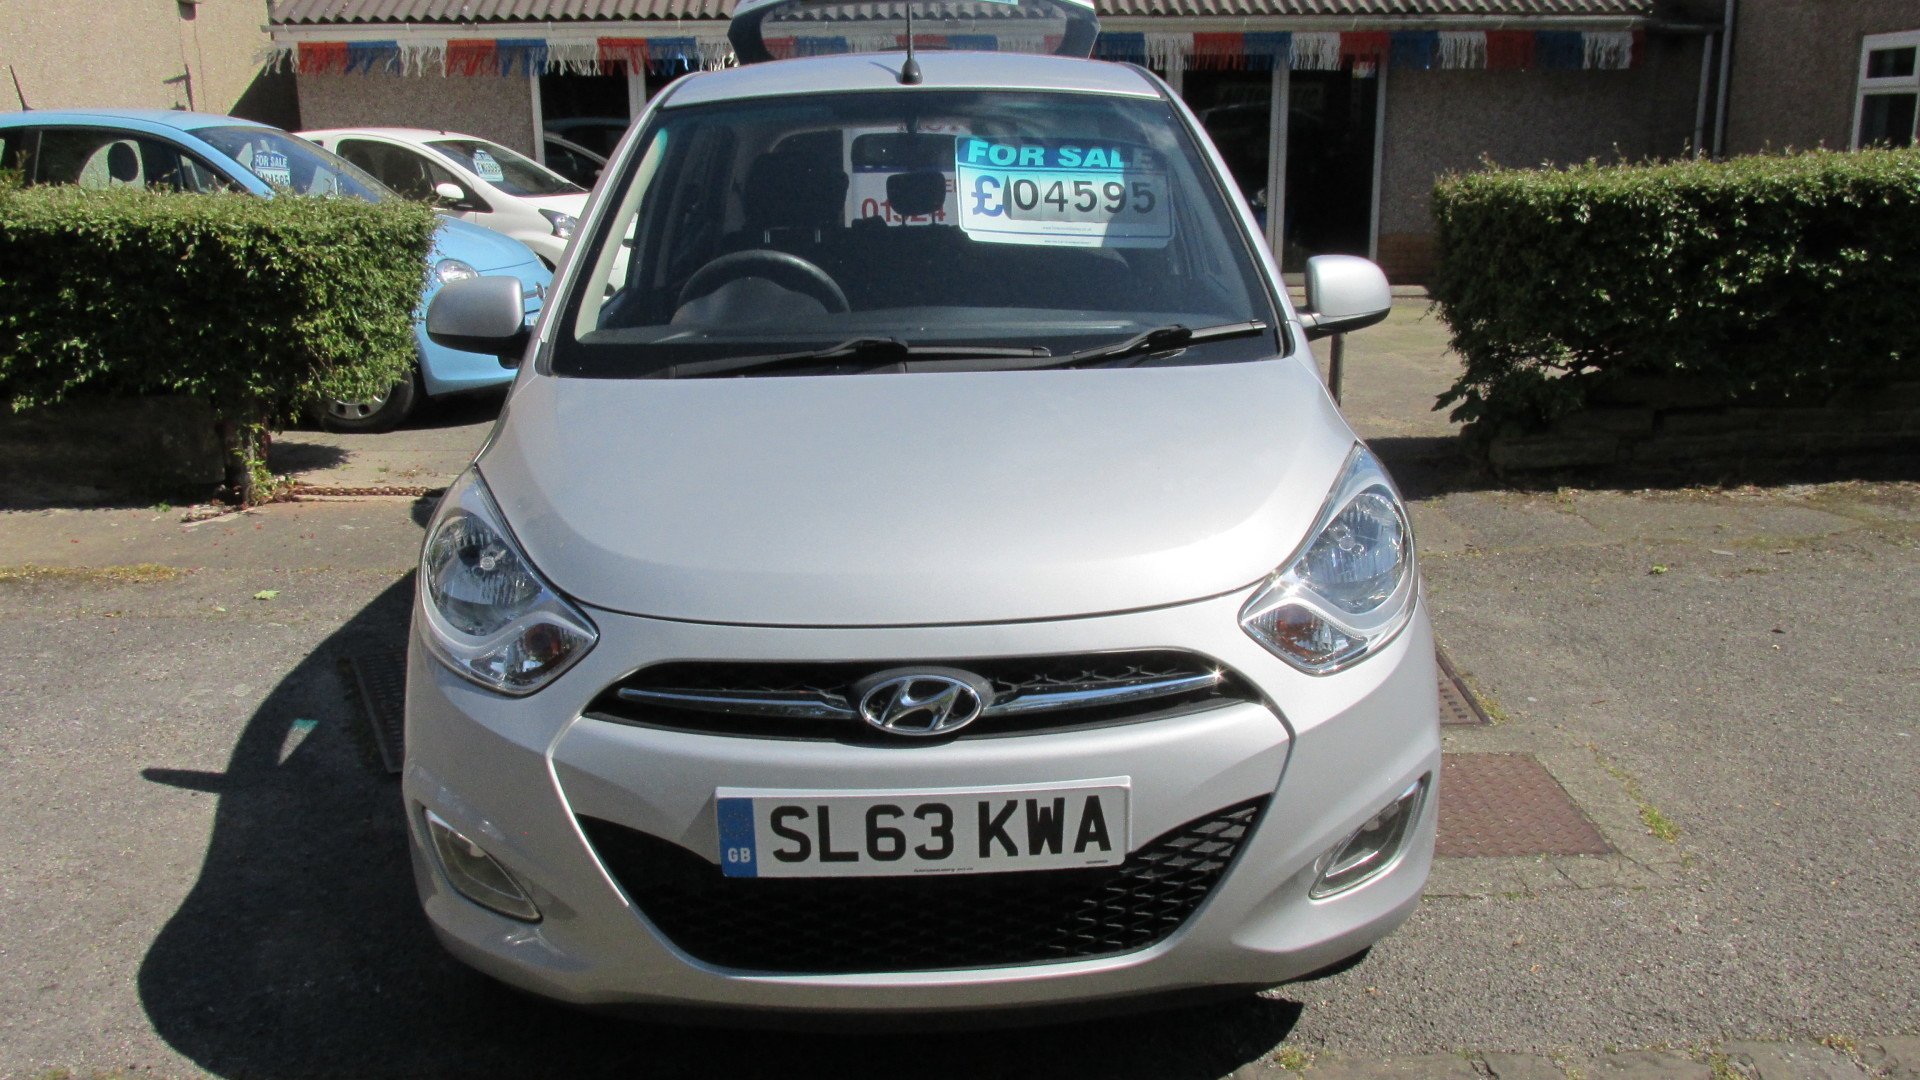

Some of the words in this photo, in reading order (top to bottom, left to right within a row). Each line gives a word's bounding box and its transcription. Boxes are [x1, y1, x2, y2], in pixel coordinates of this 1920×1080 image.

[255, 155, 269, 166] FOR
[270, 157, 288, 168] SALE
[967, 139, 1045, 166] FOR
[1057, 146, 1154, 169] SALE
[770, 803, 955, 862] SL63
[978, 795, 1112, 858] KWA
[727, 847, 751, 863] GB
